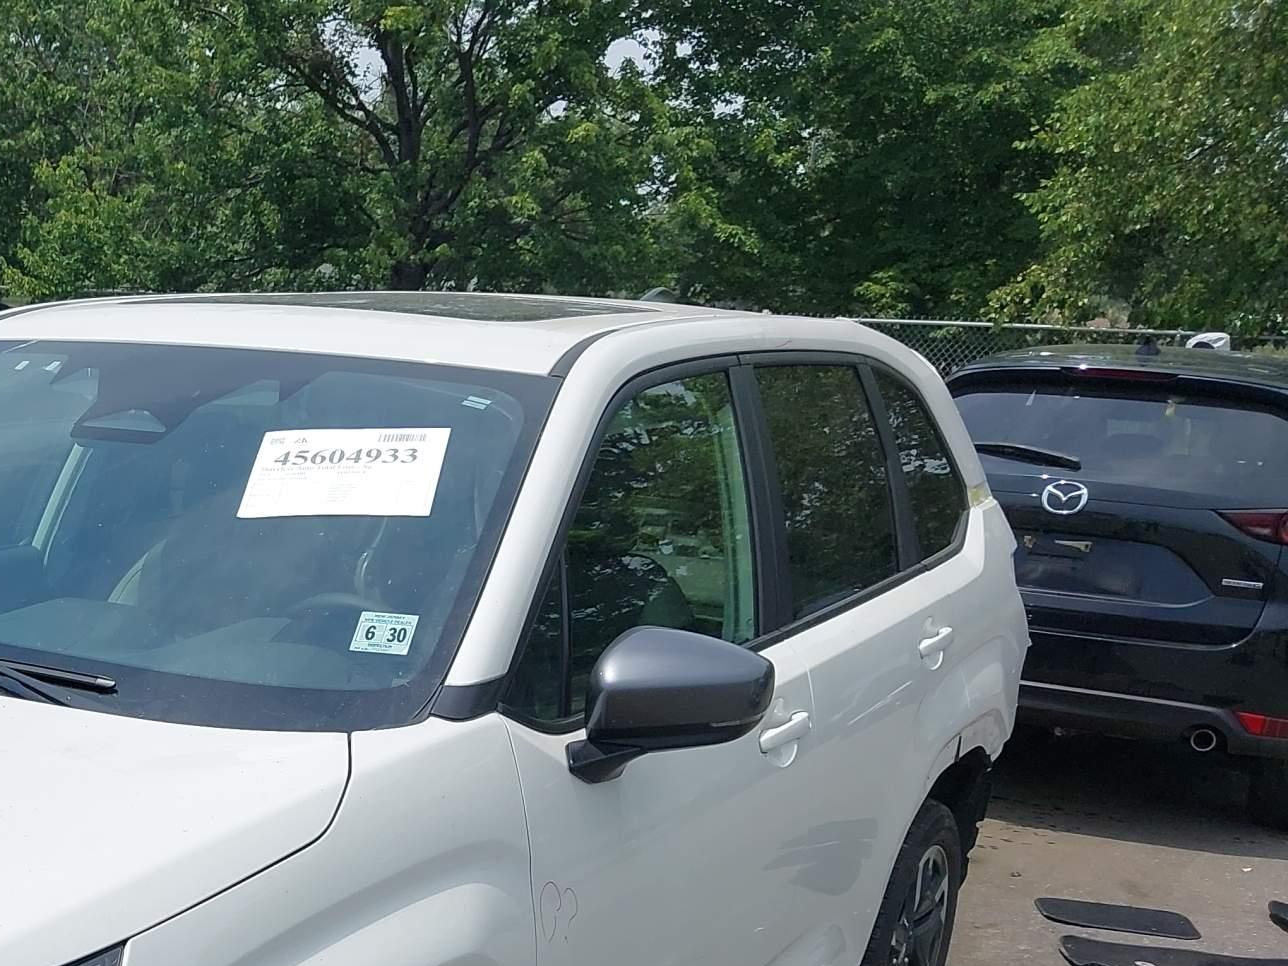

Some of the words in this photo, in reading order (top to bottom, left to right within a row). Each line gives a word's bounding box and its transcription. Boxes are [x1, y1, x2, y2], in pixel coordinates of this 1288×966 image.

[273, 448, 418, 466] 45604933
[365, 625, 377, 641] 6
[387, 627, 407, 643] 30
